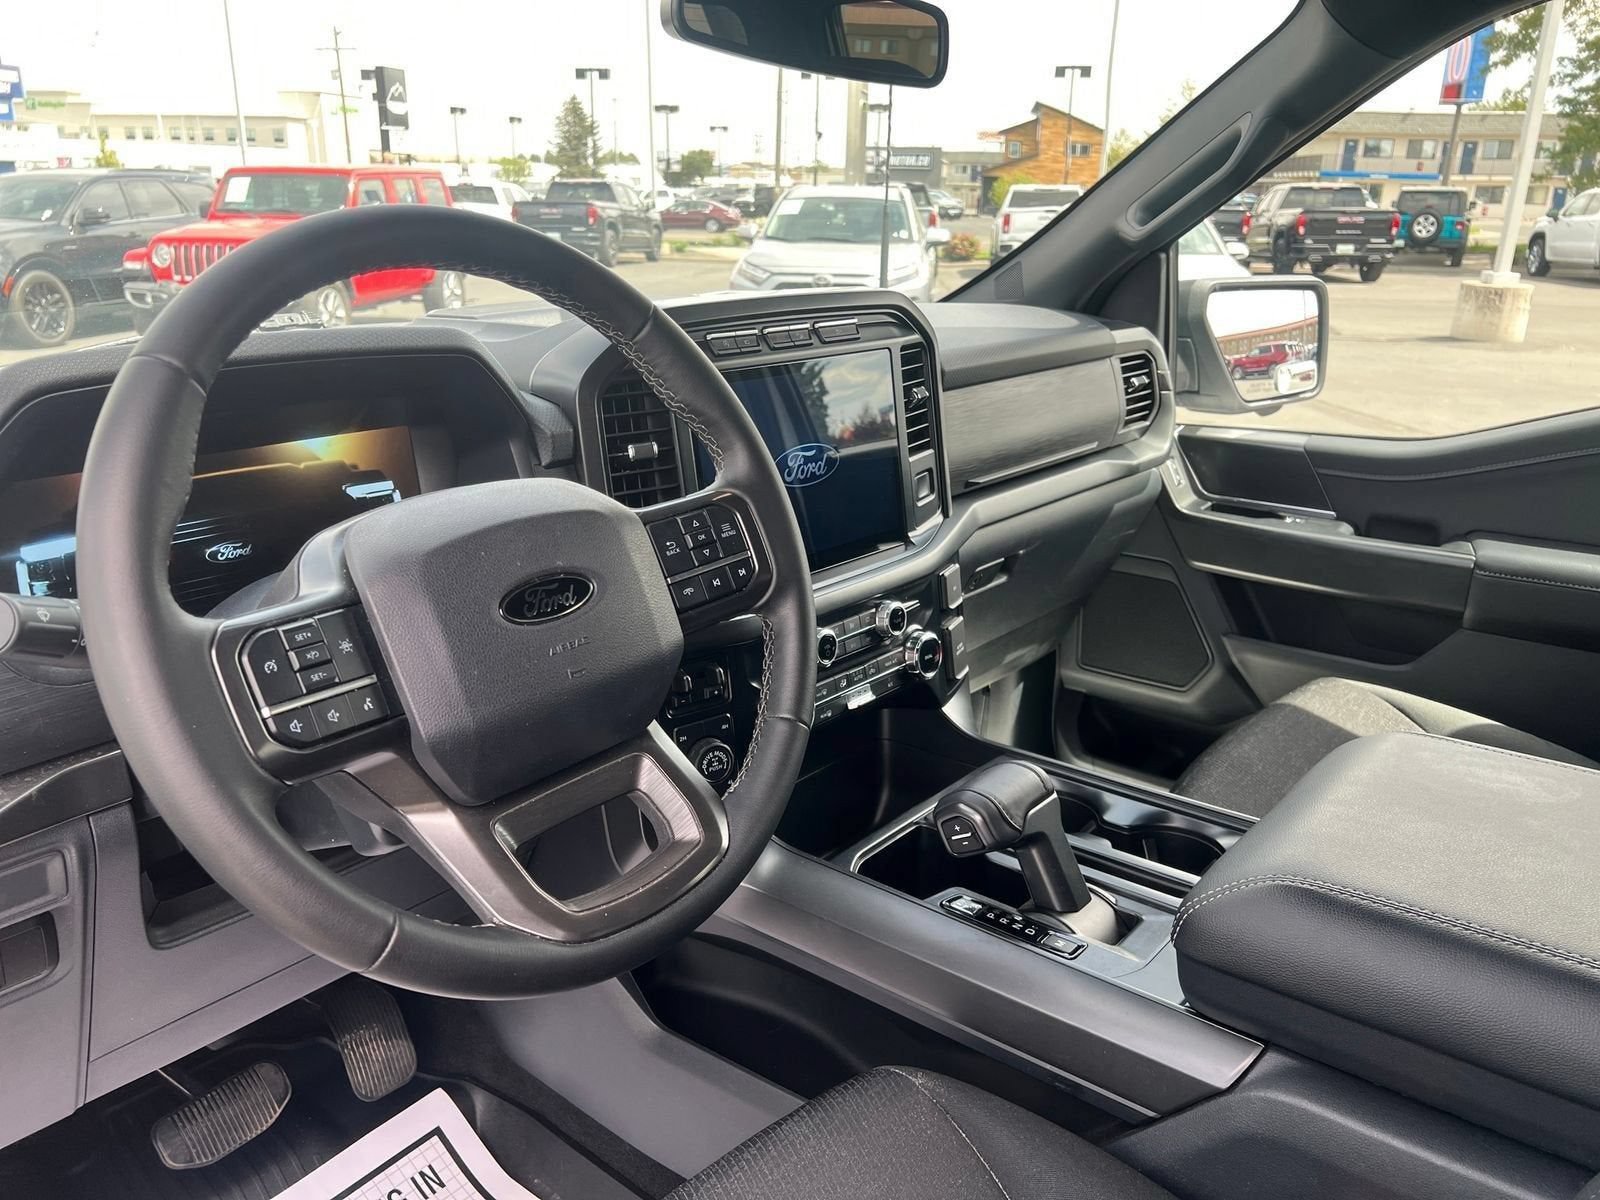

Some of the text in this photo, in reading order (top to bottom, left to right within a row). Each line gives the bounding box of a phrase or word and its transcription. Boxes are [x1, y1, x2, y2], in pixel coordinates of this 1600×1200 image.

[784, 449, 828, 483] Ford
[697, 533, 706, 541] OK
[721, 530, 736, 538] MENU
[217, 542, 253, 561] Ford
[666, 547, 681, 556] BACK
[523, 582, 578, 617] Ford
[702, 752, 714, 769] DRIVE
[713, 751, 728, 762] MODE
[410, 1164, 446, 1200] IN
